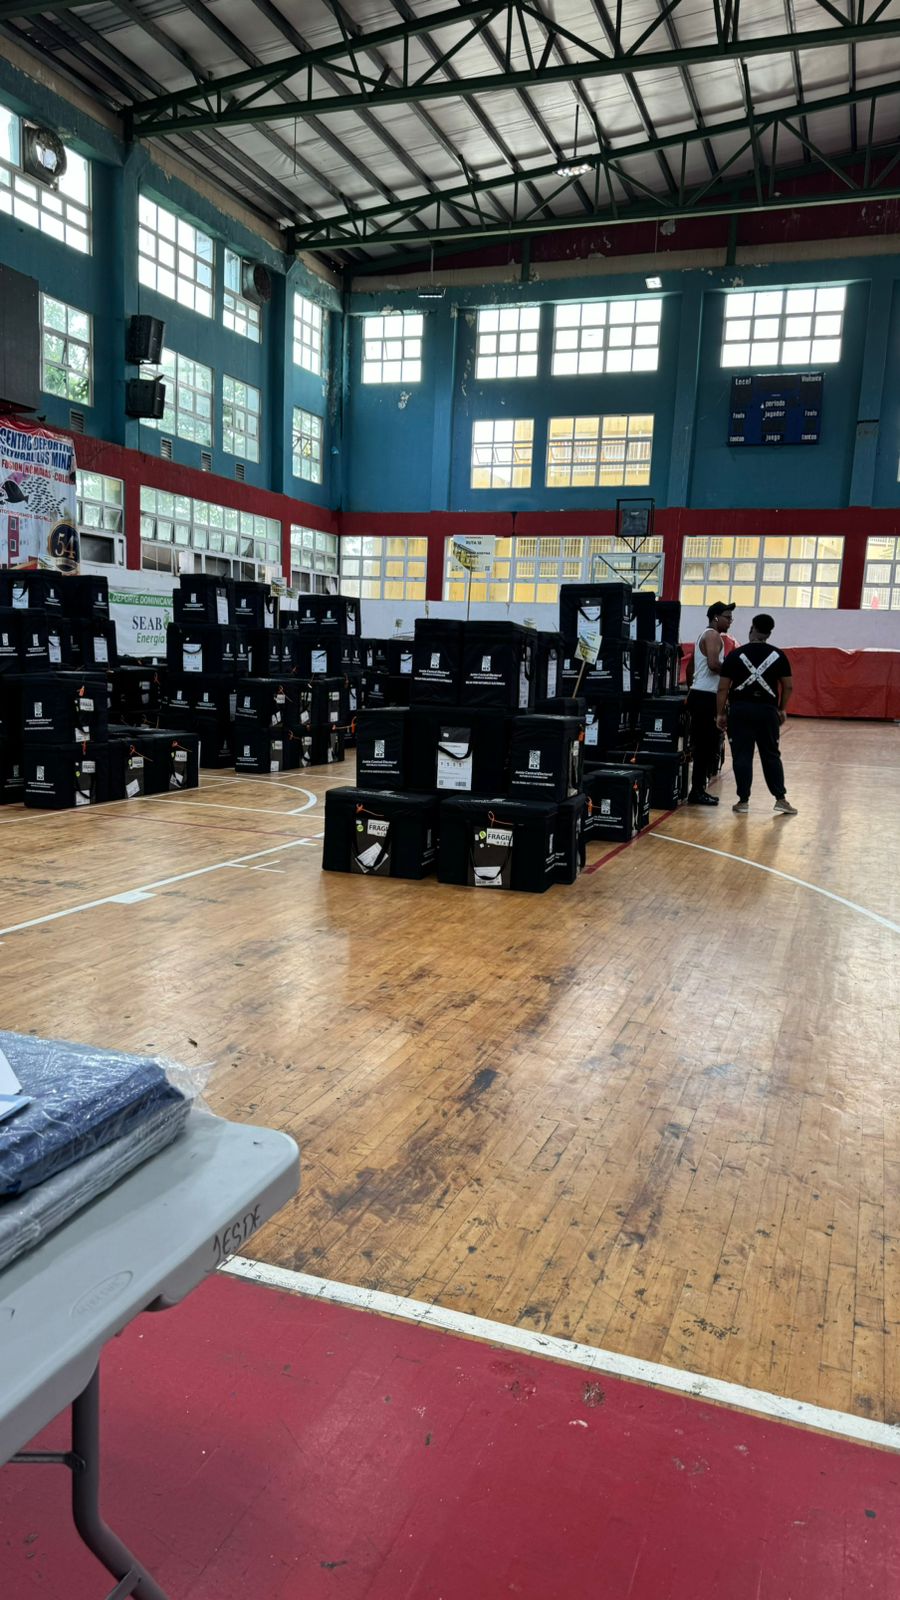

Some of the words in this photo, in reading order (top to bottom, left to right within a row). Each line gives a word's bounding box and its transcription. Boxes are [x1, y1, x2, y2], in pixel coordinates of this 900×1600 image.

[735, 378, 752, 386] Local
[764, 410, 785, 418] jugador
[0, 428, 32, 451] CENTRO
[765, 434, 781, 442] juego
[0, 445, 34, 462] ULTURAL
[54, 532, 76, 559] 54
[111, 593, 140, 604] DEPORTE
[136, 632, 165, 646] Energía
